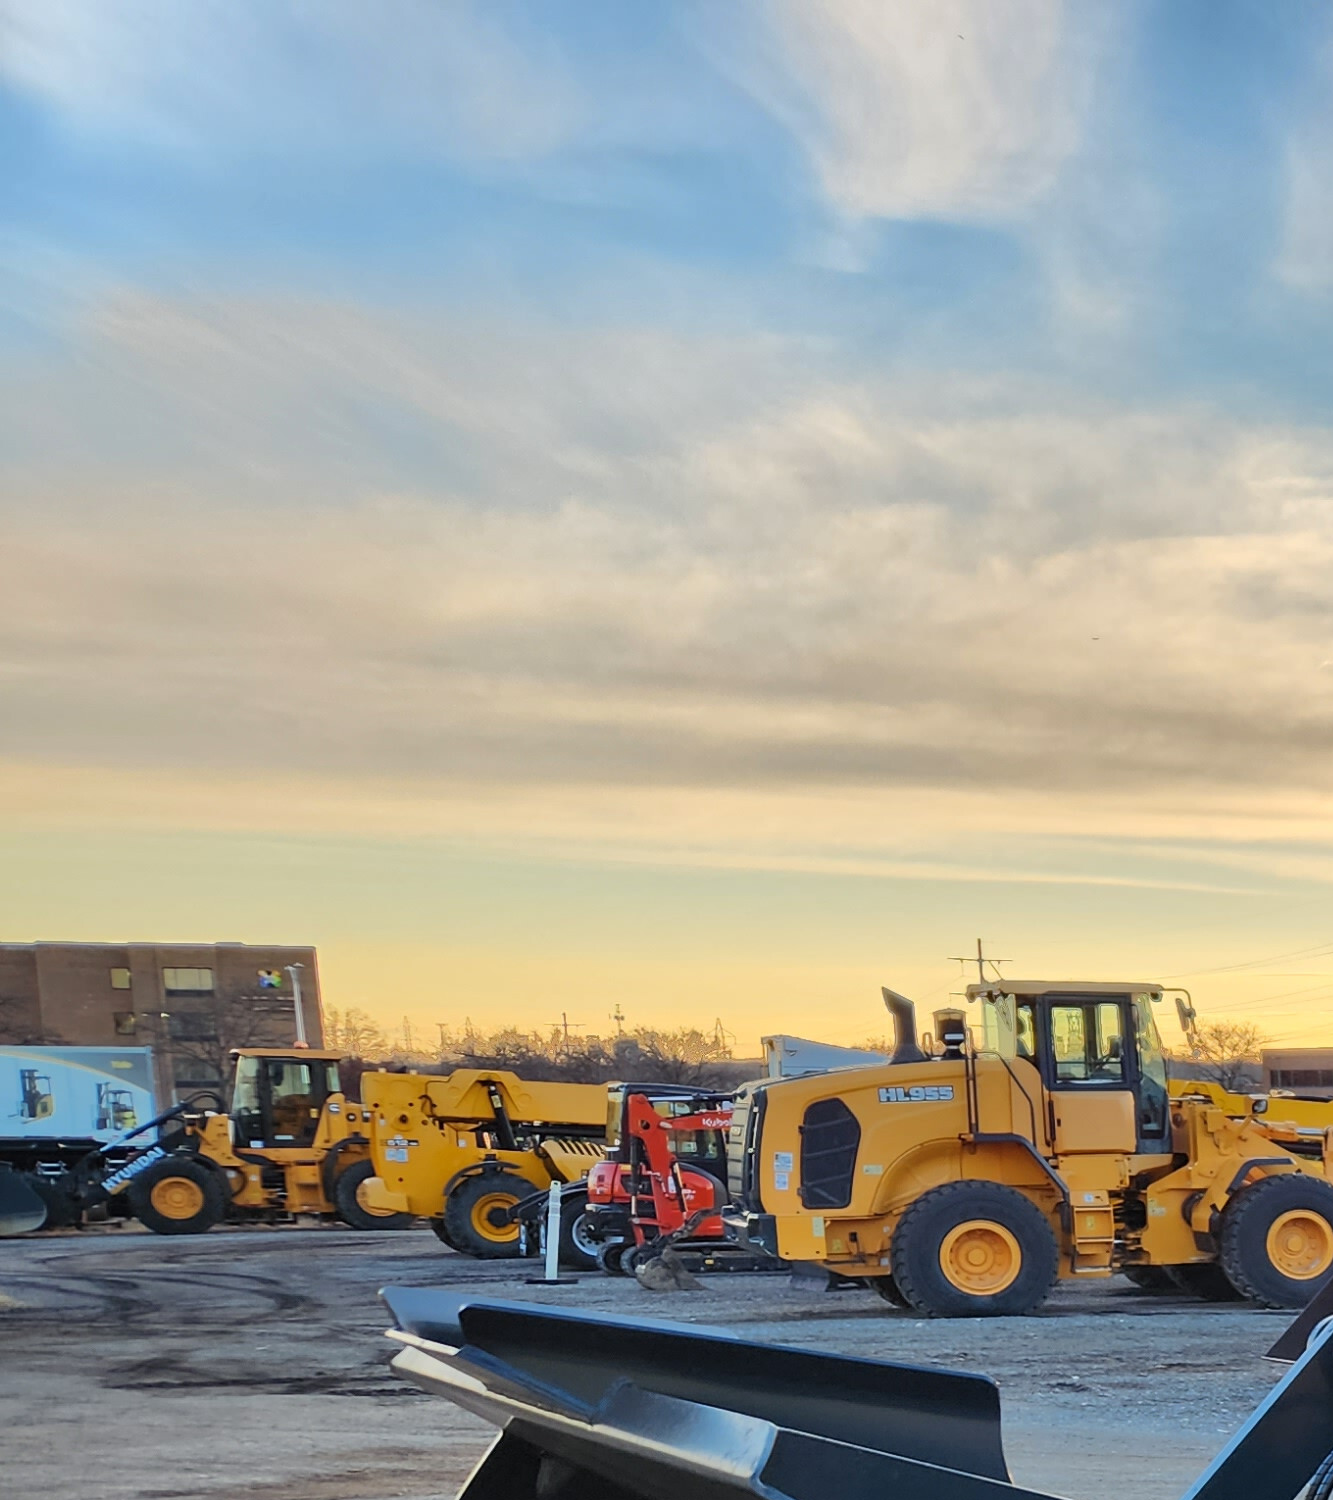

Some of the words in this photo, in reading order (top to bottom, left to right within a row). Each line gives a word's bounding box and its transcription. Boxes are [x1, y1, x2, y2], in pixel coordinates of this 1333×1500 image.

[878, 1086, 954, 1102] HL955
[702, 1117, 733, 1127] Kubo
[101, 1146, 166, 1191] HYUNDAI
